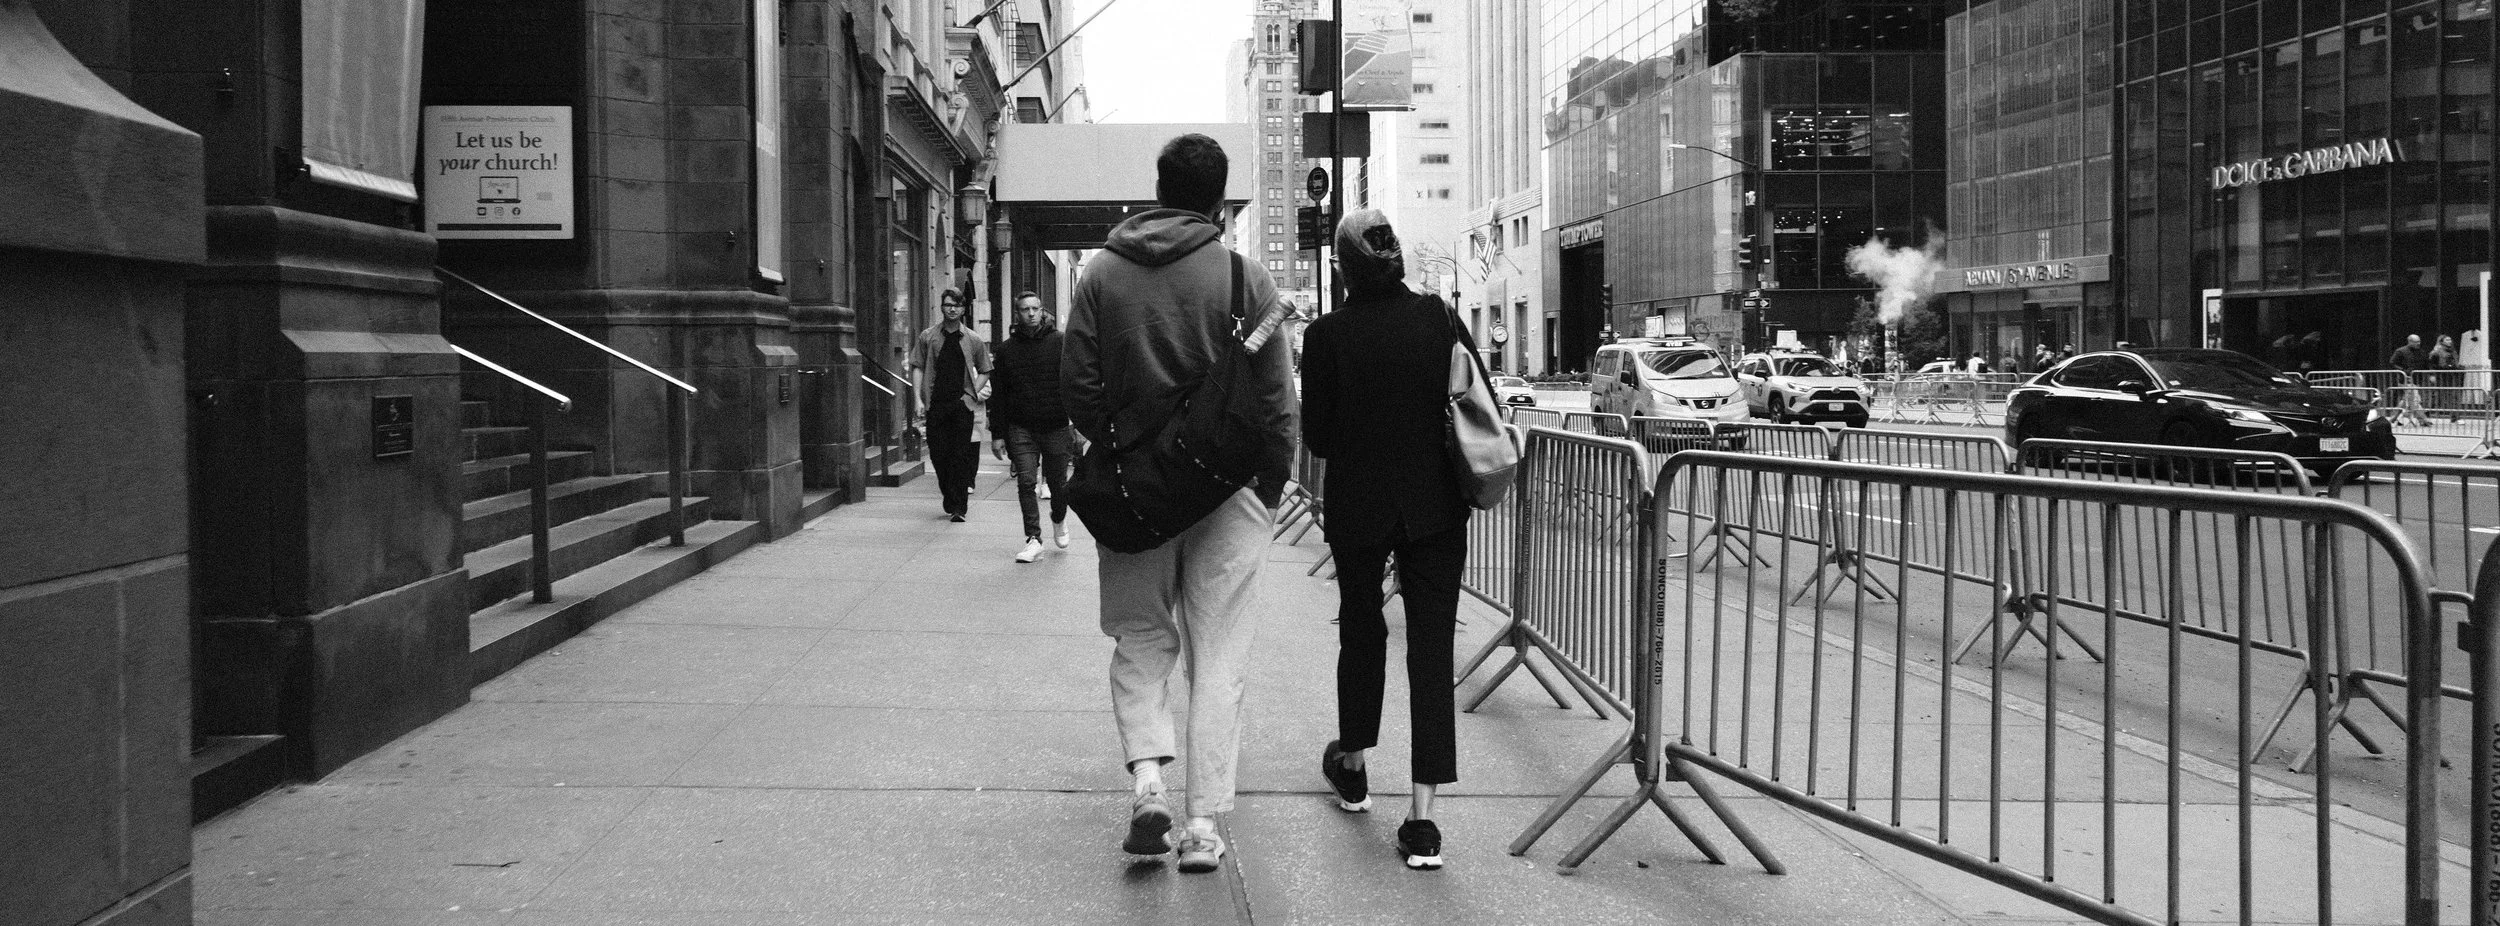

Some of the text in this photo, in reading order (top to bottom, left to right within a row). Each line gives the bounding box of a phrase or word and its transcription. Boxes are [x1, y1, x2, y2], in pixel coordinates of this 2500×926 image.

[456, 131, 542, 148] Let us be
[439, 153, 558, 175] your church!
